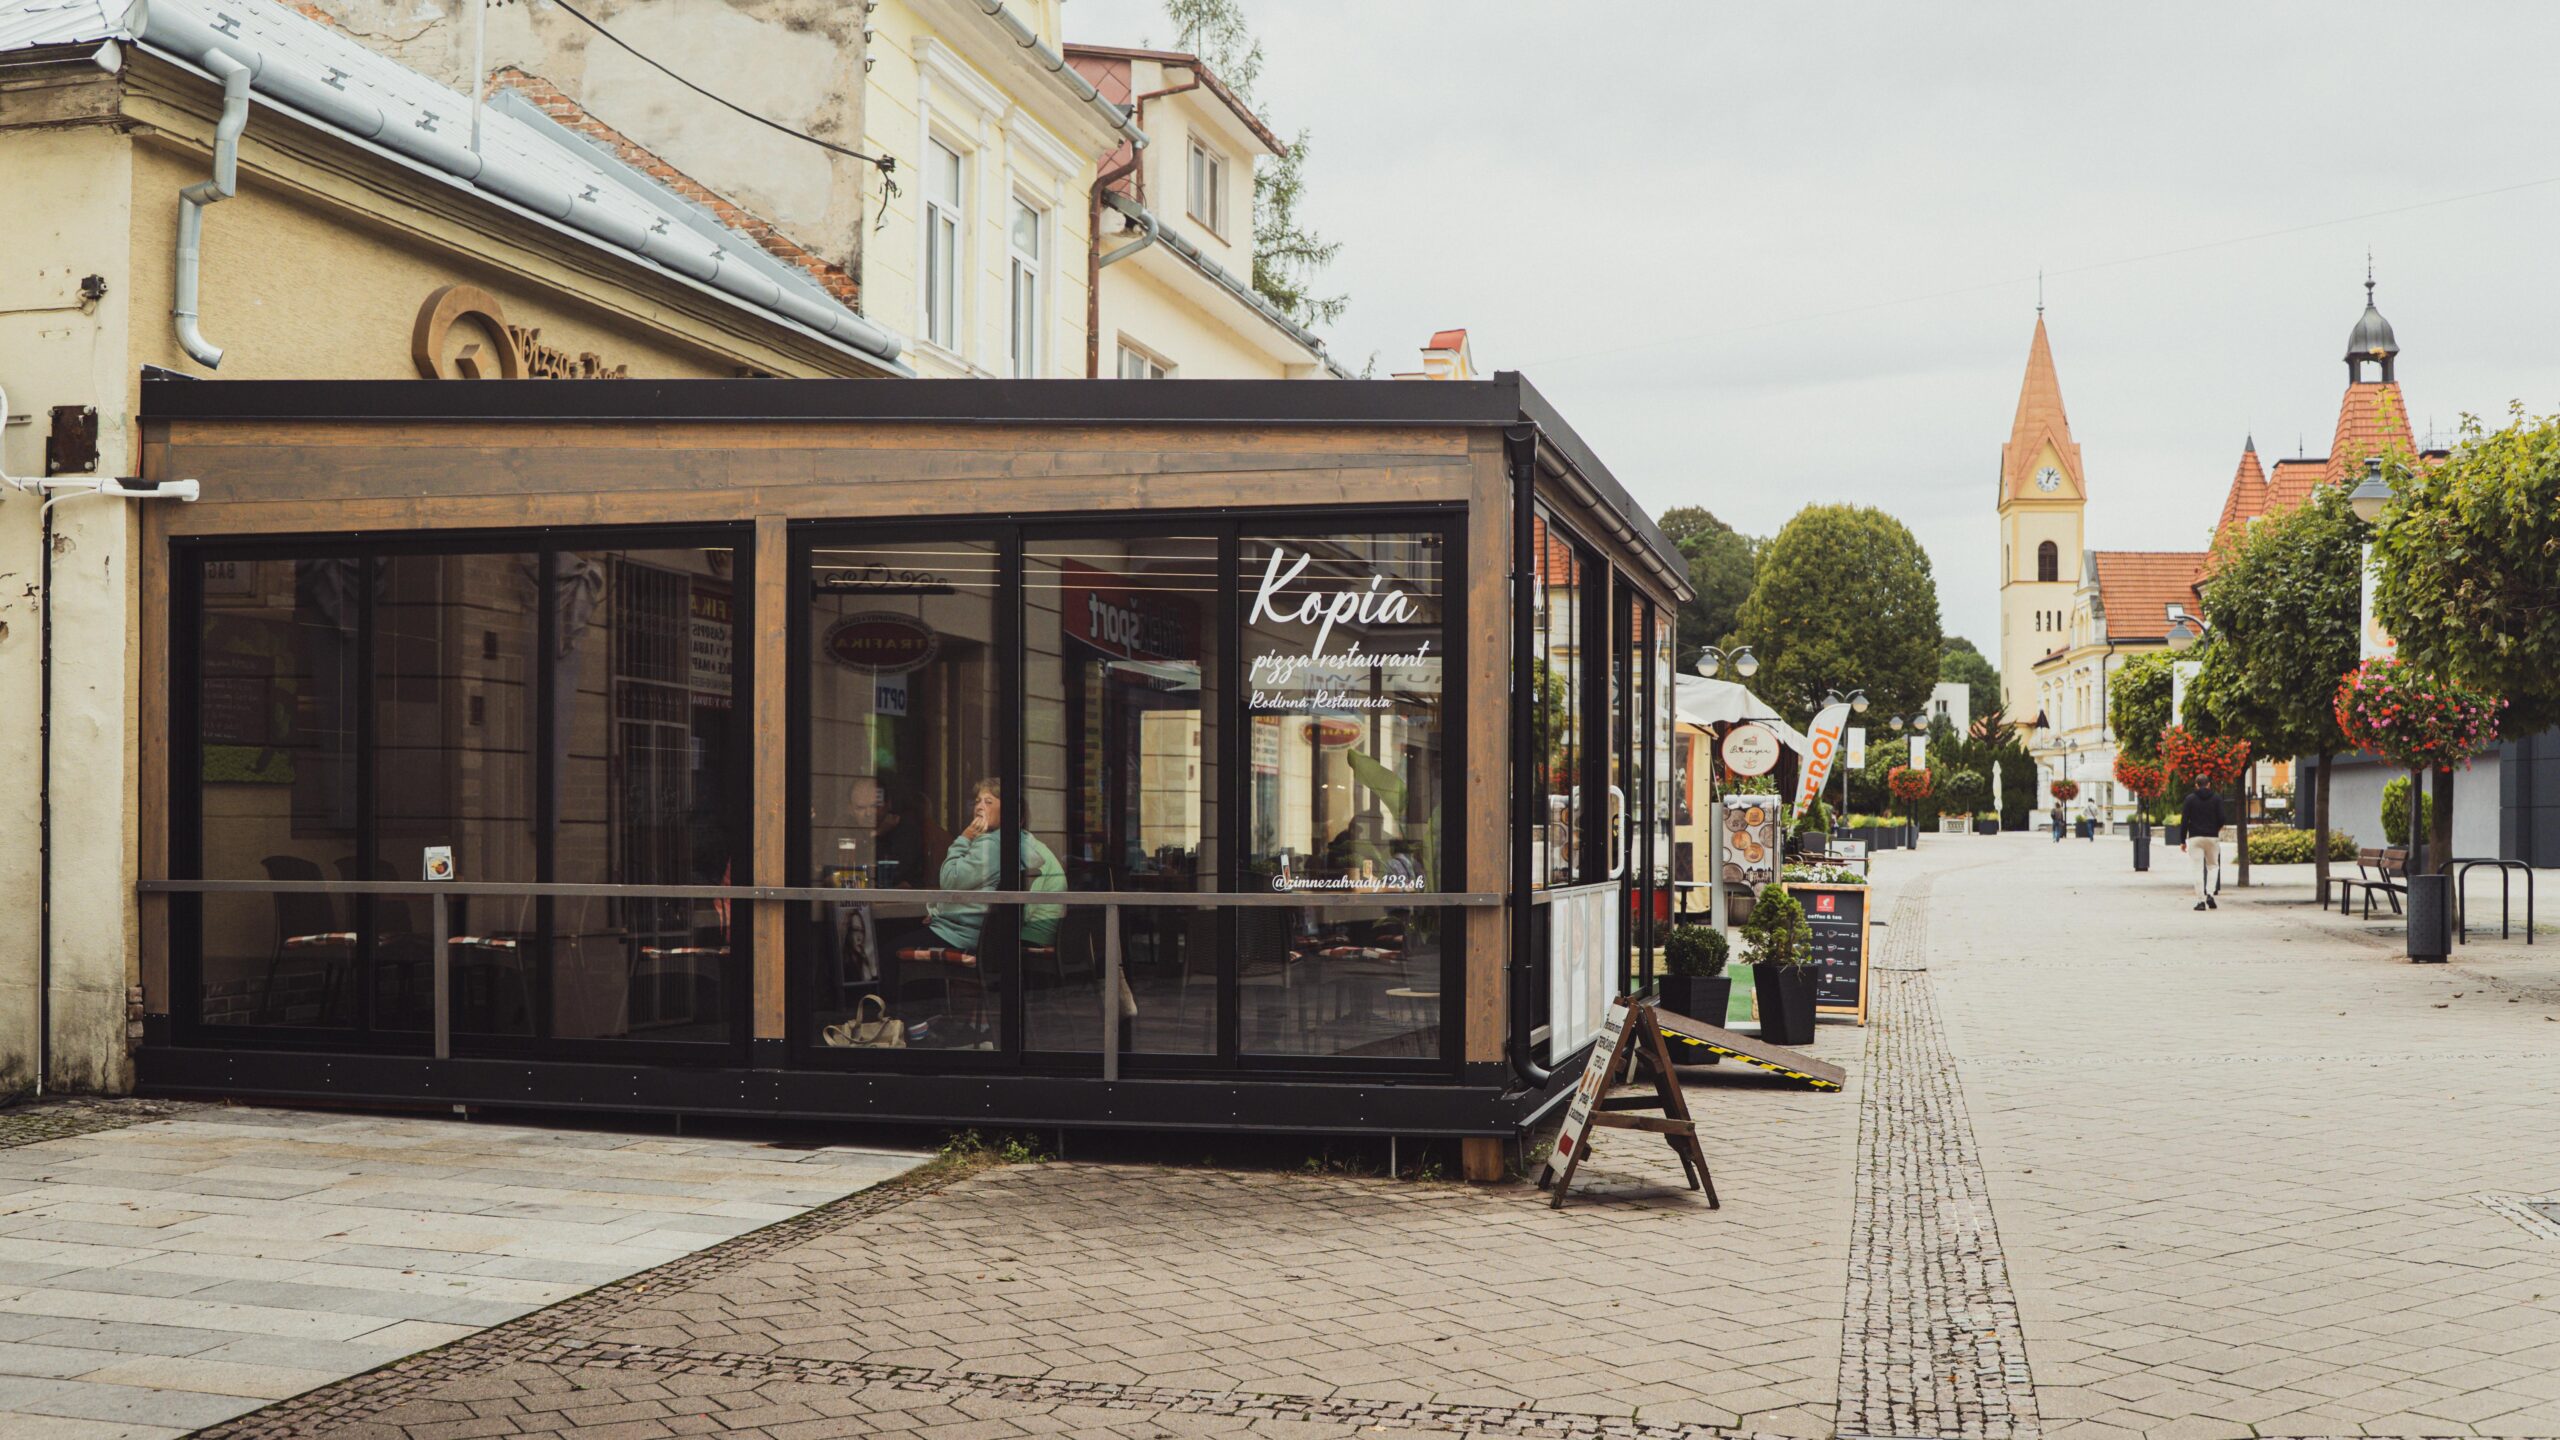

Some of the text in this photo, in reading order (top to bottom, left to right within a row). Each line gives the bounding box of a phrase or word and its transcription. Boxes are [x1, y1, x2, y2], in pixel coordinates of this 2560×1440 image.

[1249, 547, 1418, 659] Kopia
[1249, 640, 1430, 686] pizza restaurant
[1272, 874, 1425, 894] @zimnezahrady123.sk
